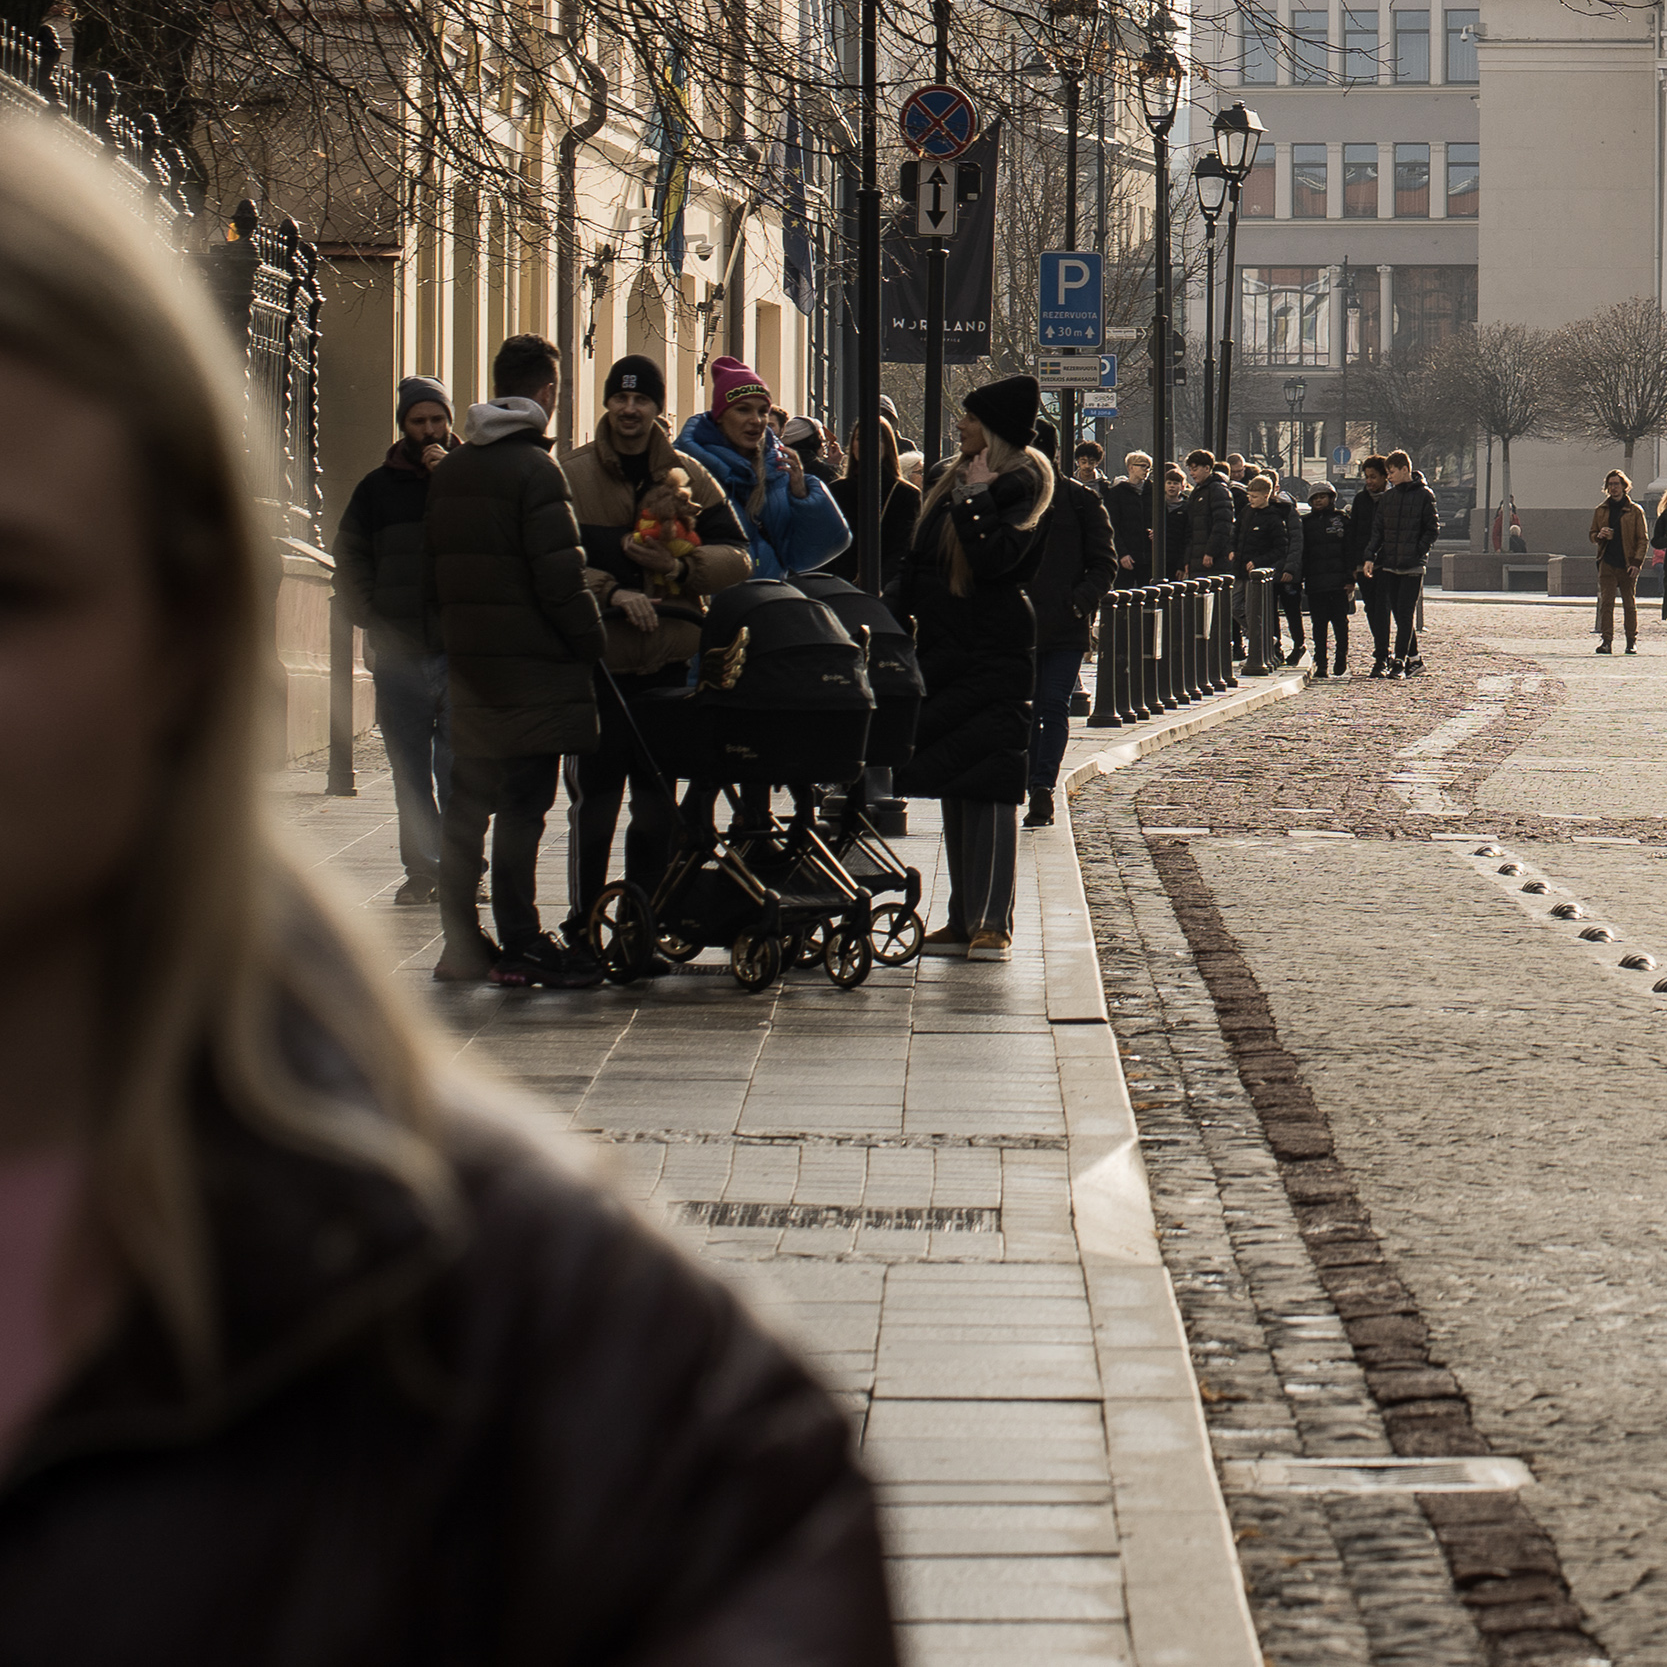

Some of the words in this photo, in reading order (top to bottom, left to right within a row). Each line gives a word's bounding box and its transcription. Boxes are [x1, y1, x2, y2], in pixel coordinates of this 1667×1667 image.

[1058, 259, 1090, 305] P
[1042, 311, 1098, 320] REZERVUOTA
[1058, 326, 1072, 336] 30
